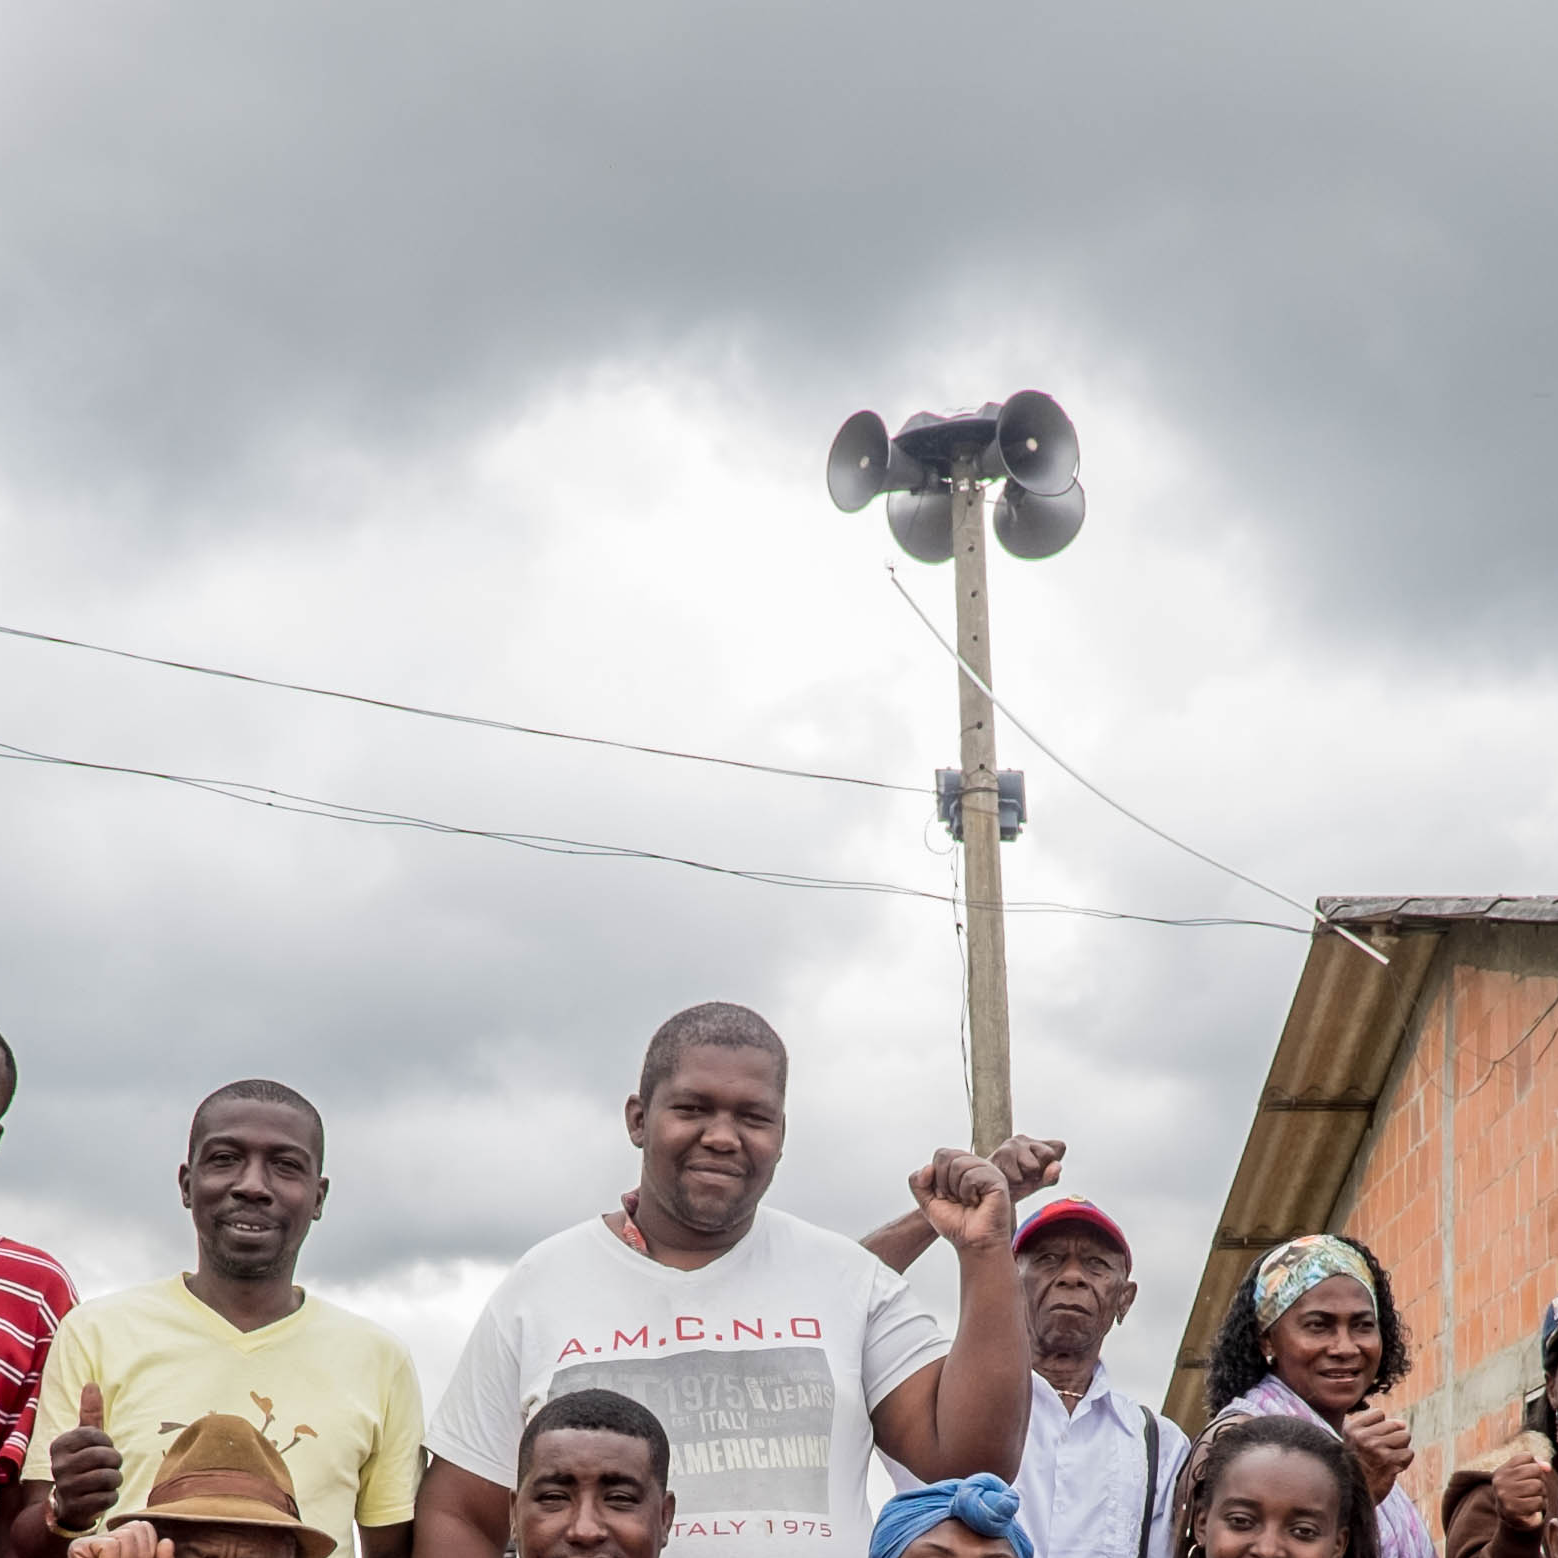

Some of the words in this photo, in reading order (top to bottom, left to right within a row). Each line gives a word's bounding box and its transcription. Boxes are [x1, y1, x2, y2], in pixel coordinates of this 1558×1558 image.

[557, 1316, 823, 1364] A.M.C.N.O
[663, 1372, 746, 1414] 1975
[770, 1383, 834, 1412] JEANS
[699, 1409, 748, 1433] ITALY
[673, 1519, 746, 1537] TALY
[766, 1519, 833, 1538] 1975
